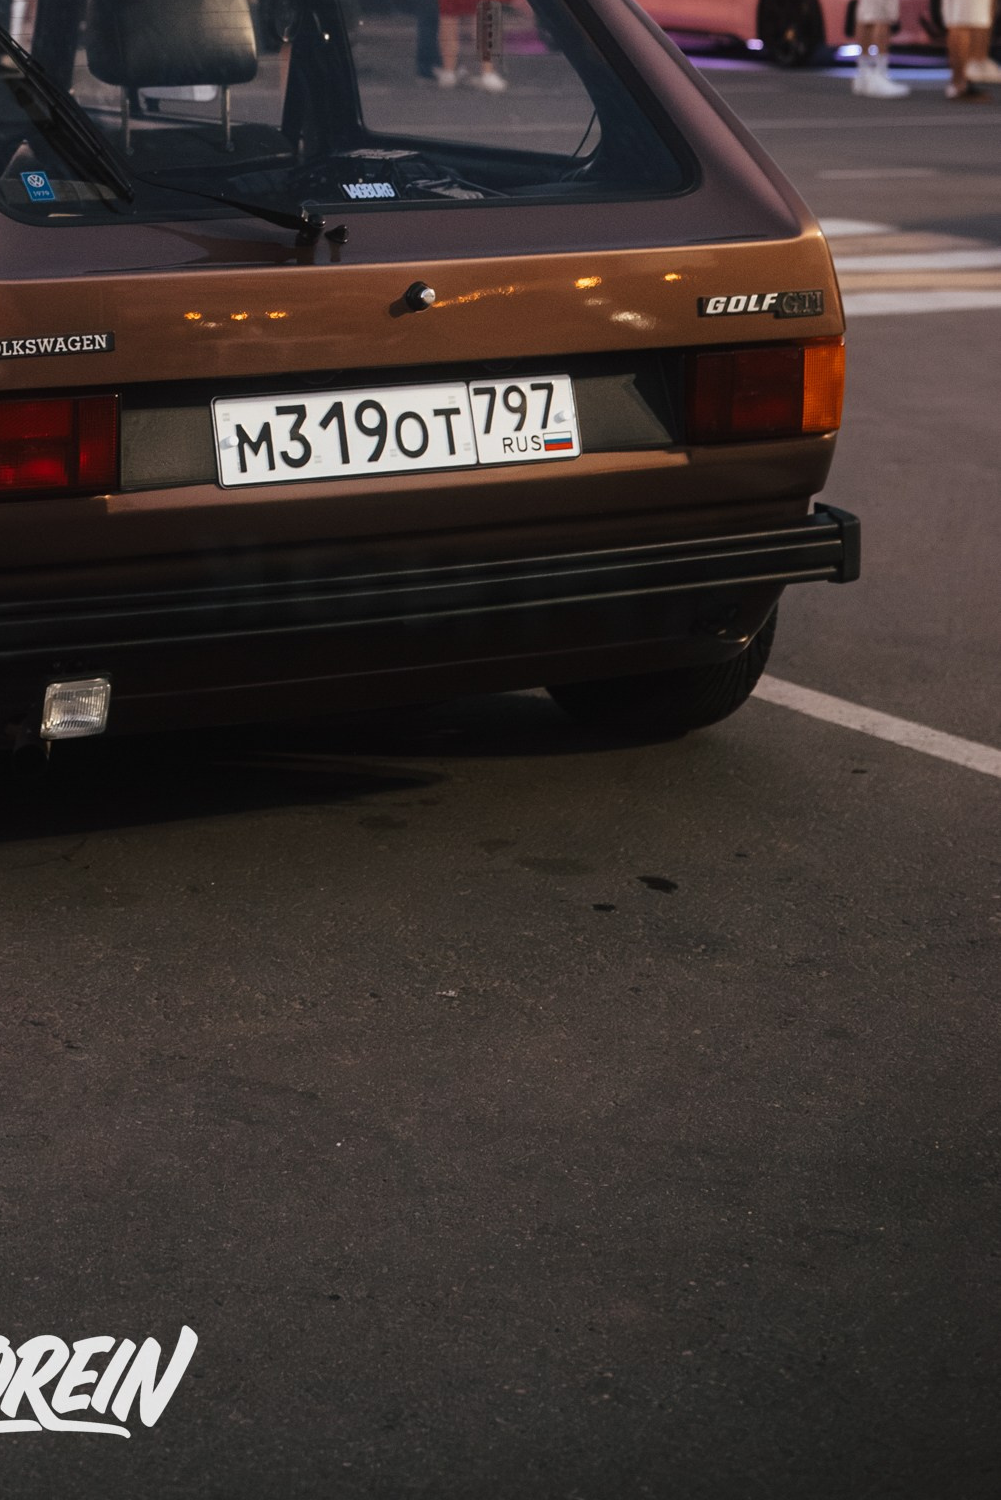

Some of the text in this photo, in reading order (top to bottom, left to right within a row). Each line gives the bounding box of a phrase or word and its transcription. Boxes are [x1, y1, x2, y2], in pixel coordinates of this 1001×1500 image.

[706, 291, 822, 314] GOLF GTI
[473, 382, 554, 434] 797
[502, 435, 542, 454] RUS
